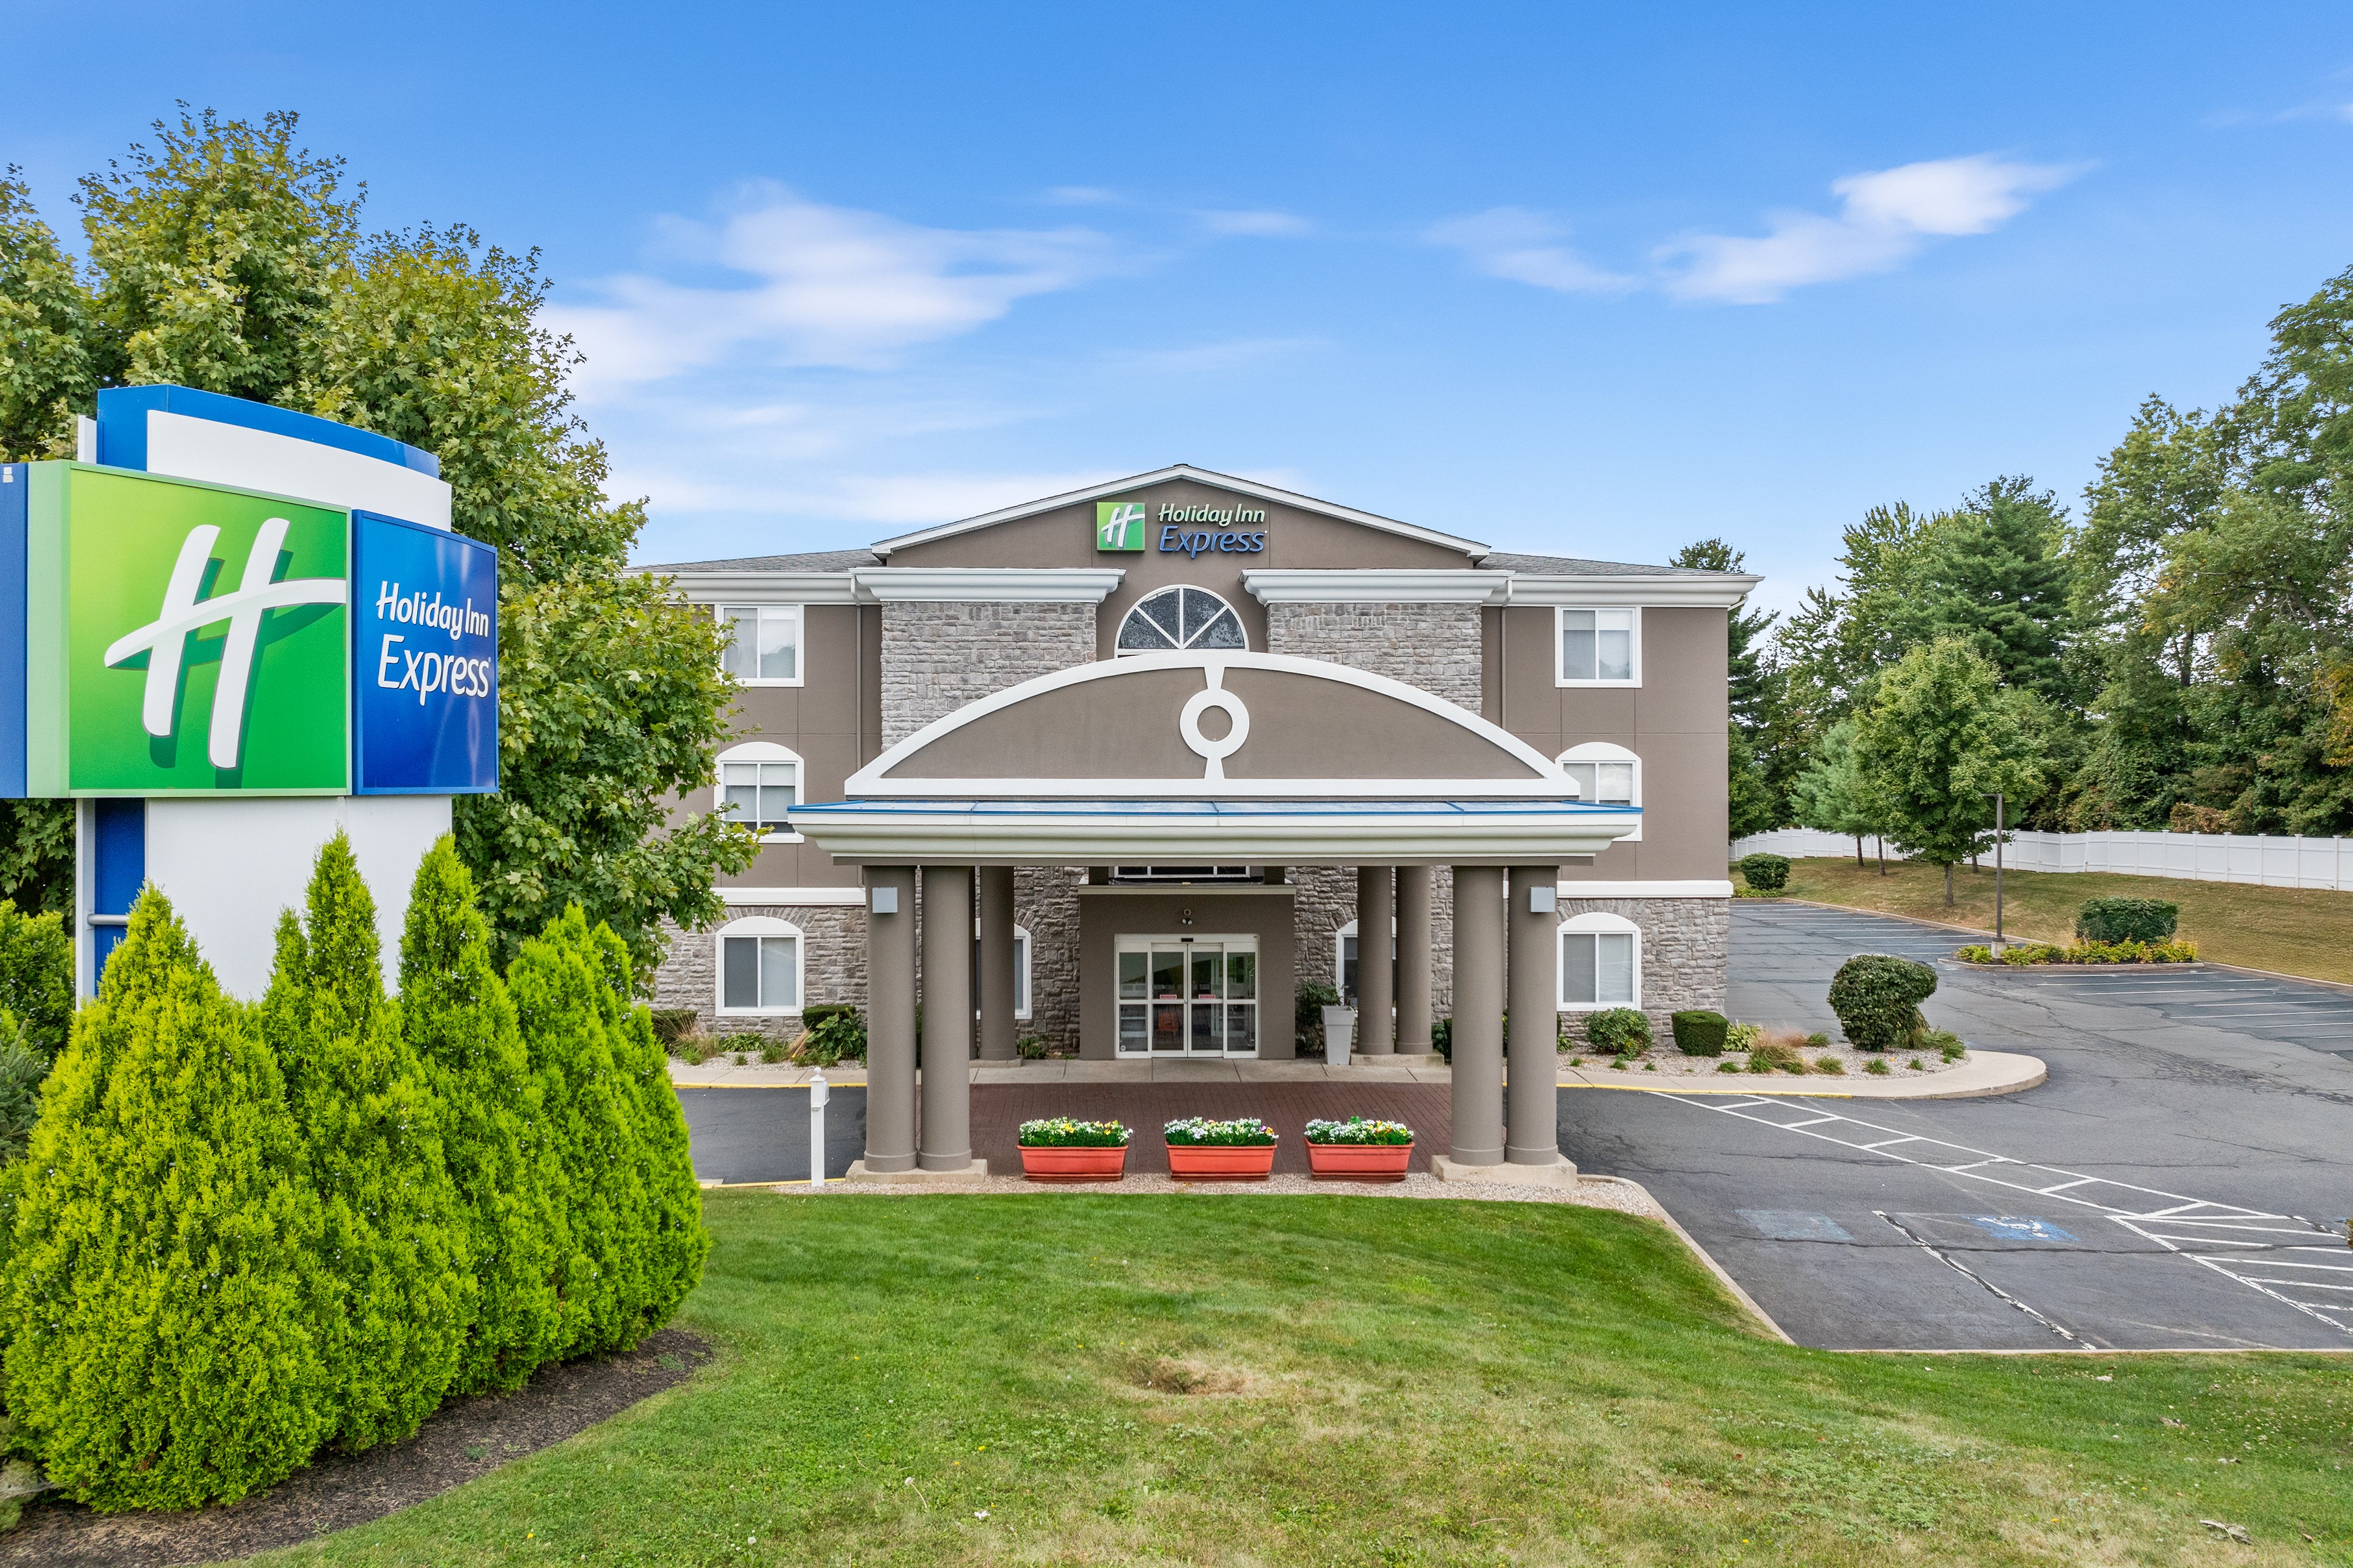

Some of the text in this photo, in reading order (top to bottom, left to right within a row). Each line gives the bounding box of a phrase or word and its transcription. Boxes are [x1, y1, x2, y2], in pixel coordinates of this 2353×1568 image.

[1158, 503, 1265, 527] Holiday Inn
[1159, 525, 1265, 559] Express
[376, 580, 489, 640] Holiday Inn
[378, 633, 489, 706] Express
